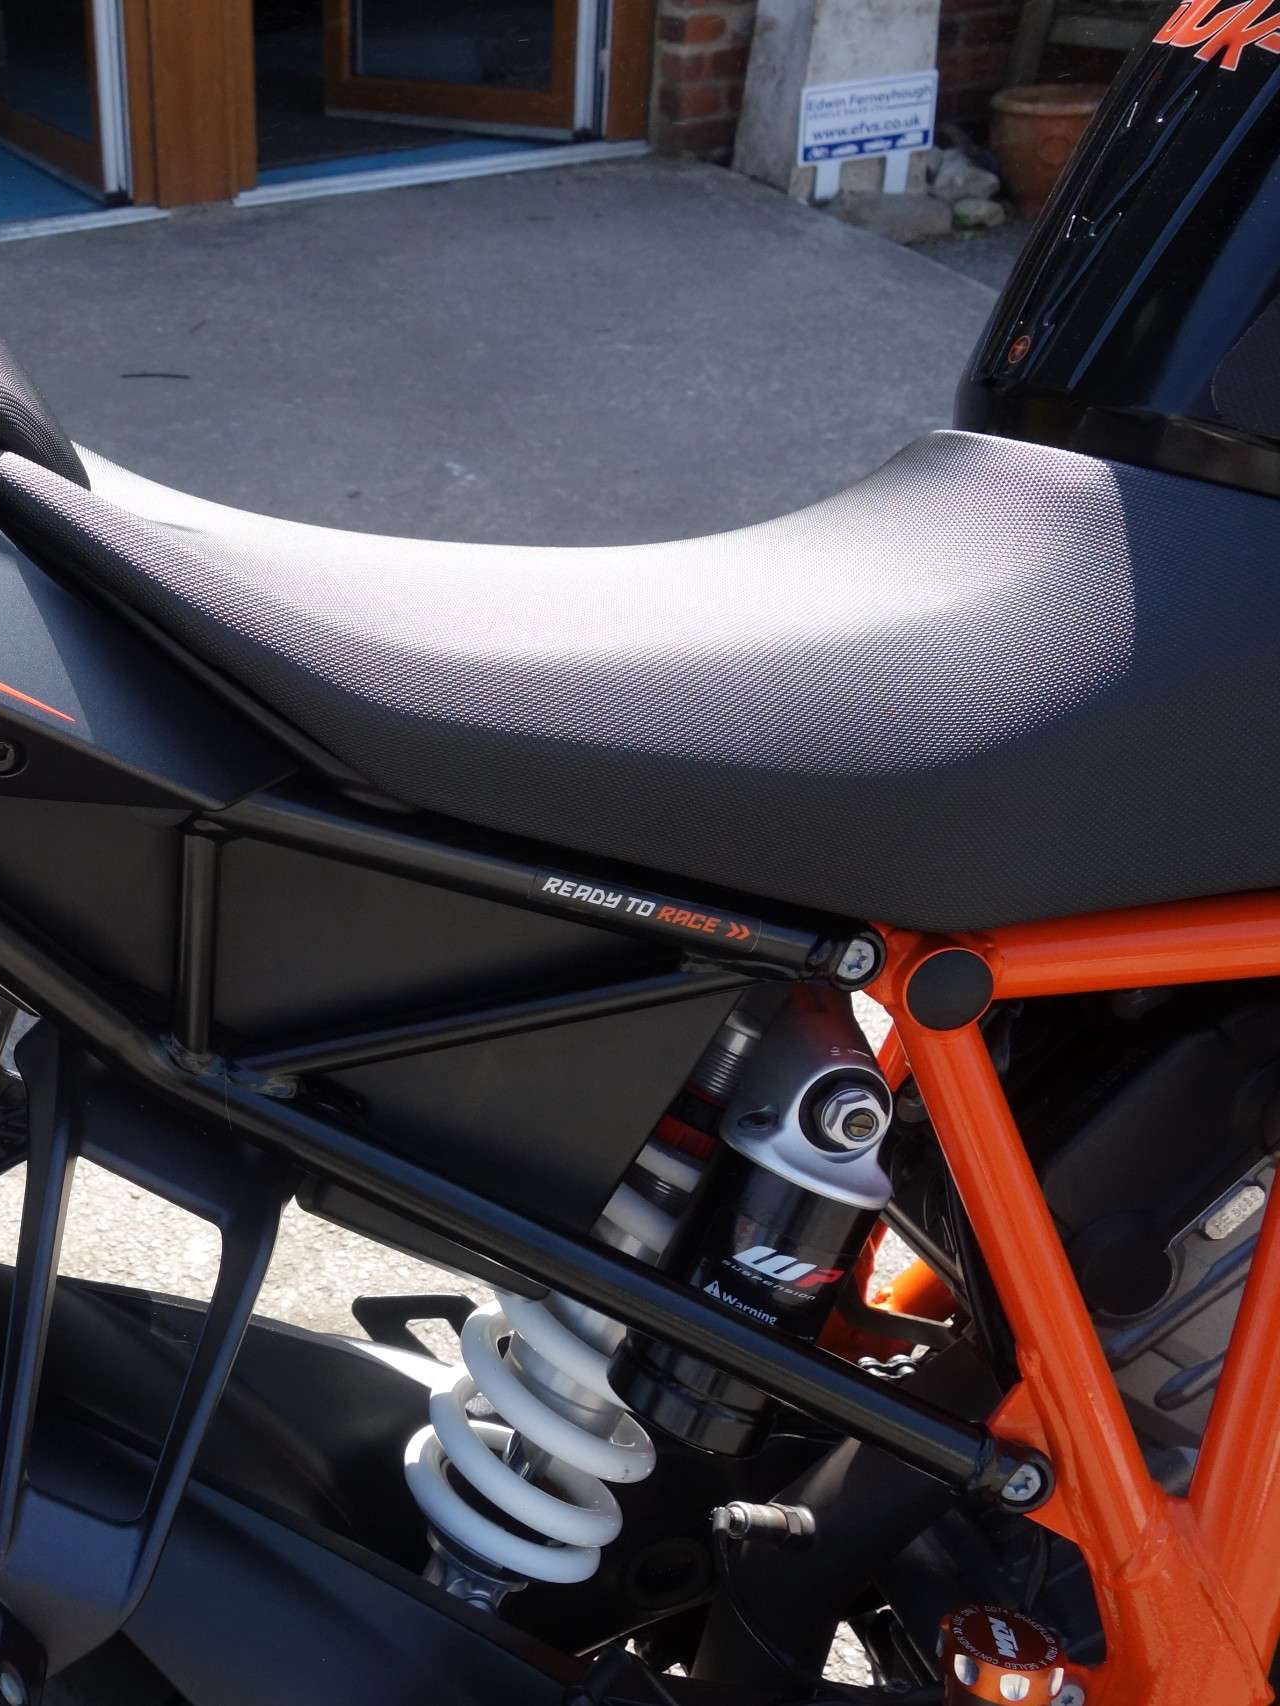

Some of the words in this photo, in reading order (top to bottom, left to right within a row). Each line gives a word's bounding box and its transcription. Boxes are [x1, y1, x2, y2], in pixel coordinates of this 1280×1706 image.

[542, 876, 623, 909] READY
[625, 896, 656, 917] TO
[656, 905, 721, 933] RACE
[722, 1291, 778, 1326] Warning
[987, 1615, 1019, 1659] KTM
